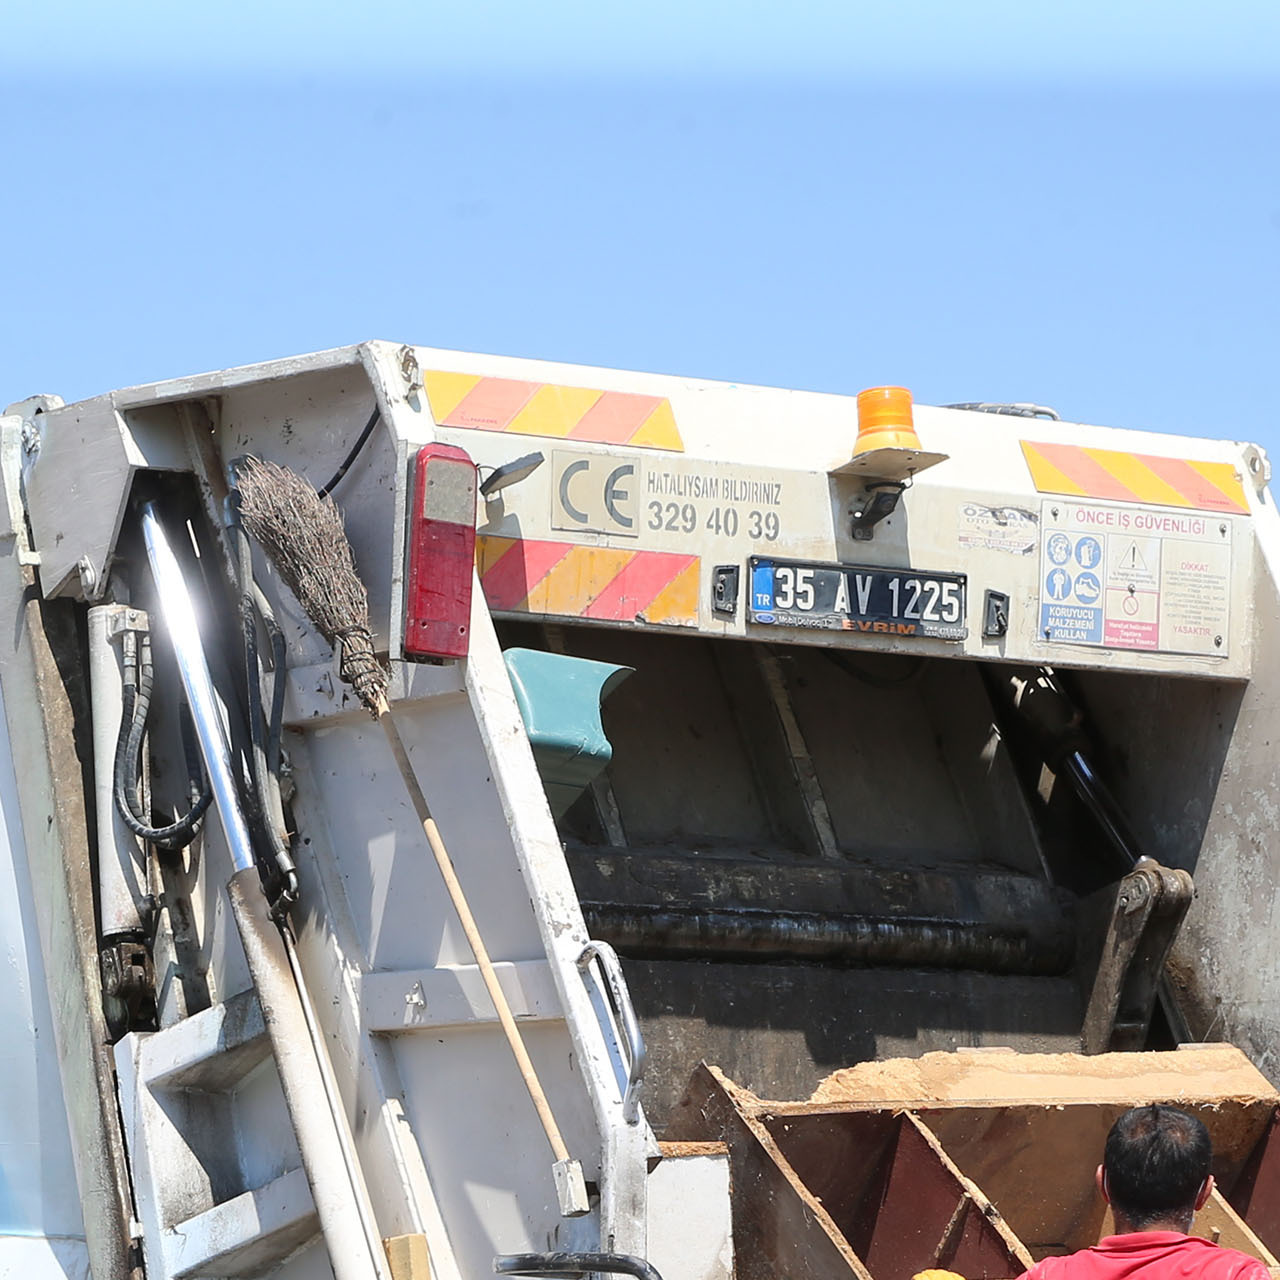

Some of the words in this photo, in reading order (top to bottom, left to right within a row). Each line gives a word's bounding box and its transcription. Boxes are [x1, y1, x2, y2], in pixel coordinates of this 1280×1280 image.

[647, 471, 719, 499] HATALIYSAM
[647, 501, 697, 533] 329
[706, 507, 738, 537] 40
[748, 510, 780, 541] 39
[1076, 508, 1114, 525] ÖNCE
[1118, 511, 1131, 530] İŞ
[1135, 514, 1206, 535] GÜVENLİĞİ
[756, 593, 770, 606] TR
[775, 567, 814, 610] 35
[834, 573, 872, 615] AV
[888, 578, 959, 622] 1225
[1050, 606, 1094, 620] KORUYUCU
[1055, 628, 1087, 640] KULLAN
